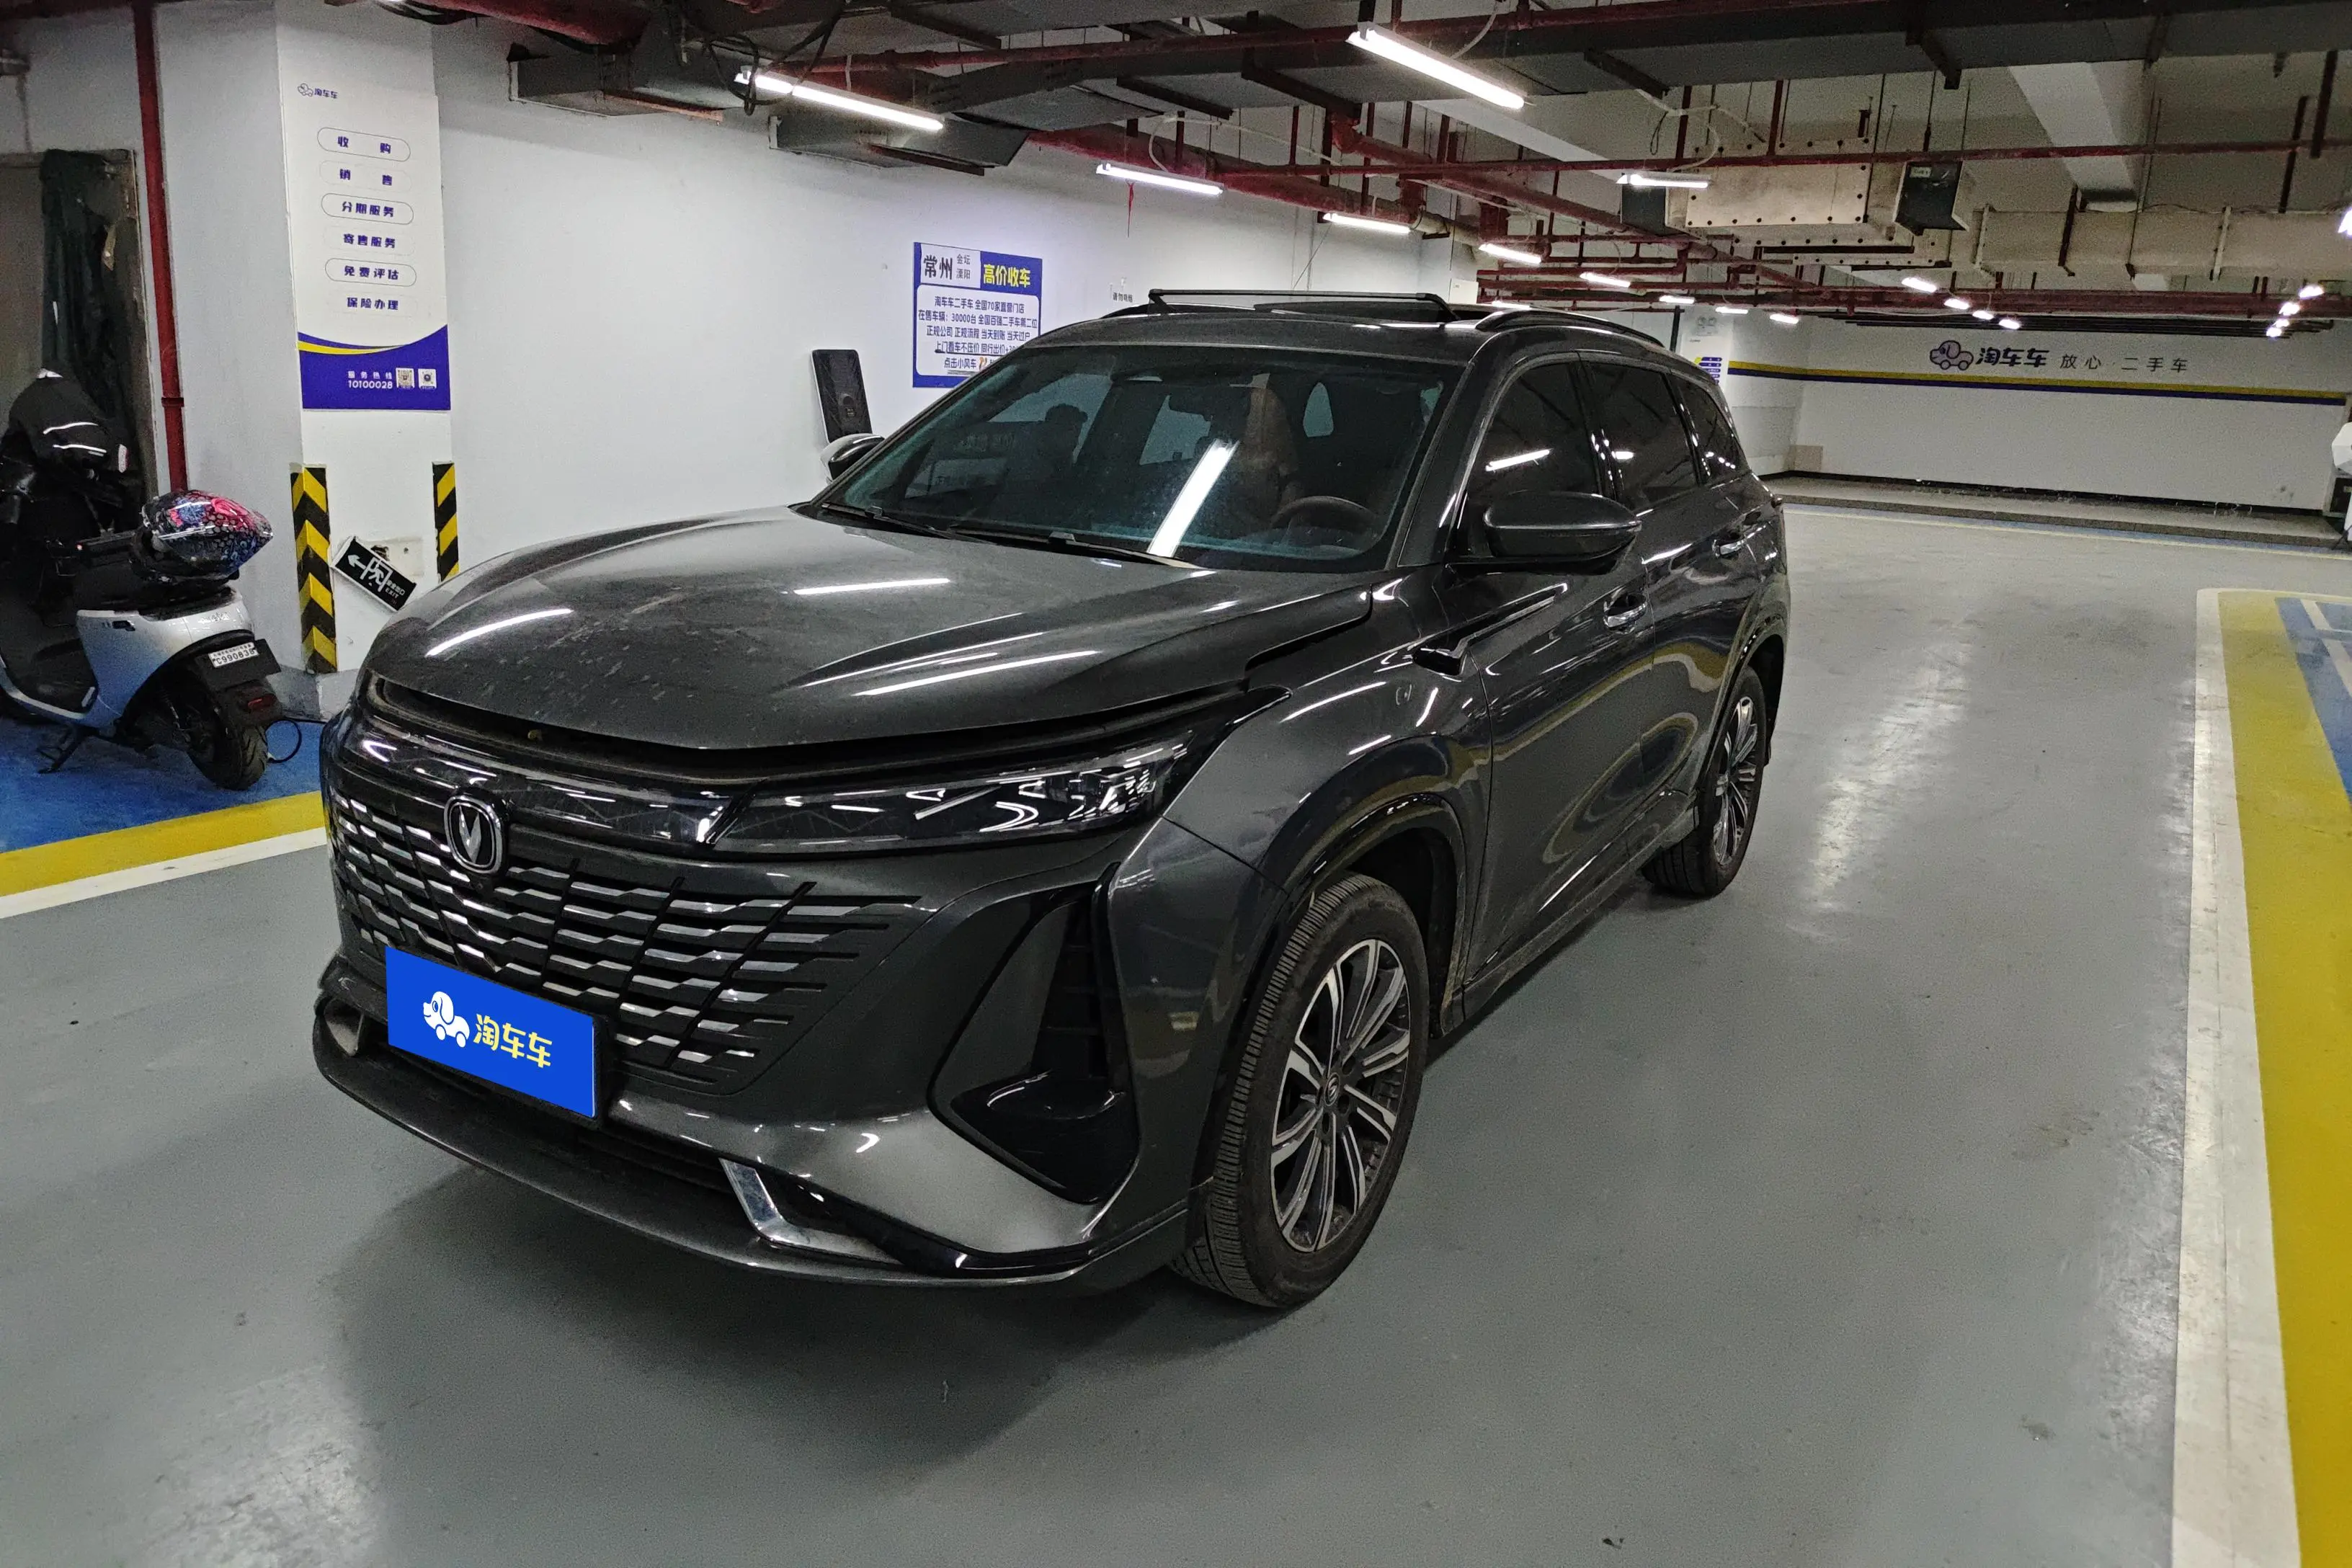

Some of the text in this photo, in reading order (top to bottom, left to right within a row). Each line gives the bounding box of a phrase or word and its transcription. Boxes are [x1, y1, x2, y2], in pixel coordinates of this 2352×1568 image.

[314, 88, 338, 99] 淘车车
[342, 201, 394, 218] 分期服务
[343, 233, 396, 249] 寄售服务
[923, 254, 953, 280] 常州
[956, 254, 971, 265] 金坛
[344, 265, 399, 280] 免费评估
[983, 264, 1030, 288] 高价收车
[347, 297, 399, 311] 保险办理
[935, 296, 1025, 314] 淘车车二手车 全国70家直营门店
[927, 325, 1030, 342] 正规公司 正规流程 当天到账 当天过户
[936, 341, 979, 353] 上门看车不压价
[944, 357, 976, 369] 点击小风车
[1975, 347, 2050, 368] 淘车车
[2121, 357, 2188, 373] 二手车
[348, 380, 393, 389] 10100028
[385, 587, 399, 599] EXIT
